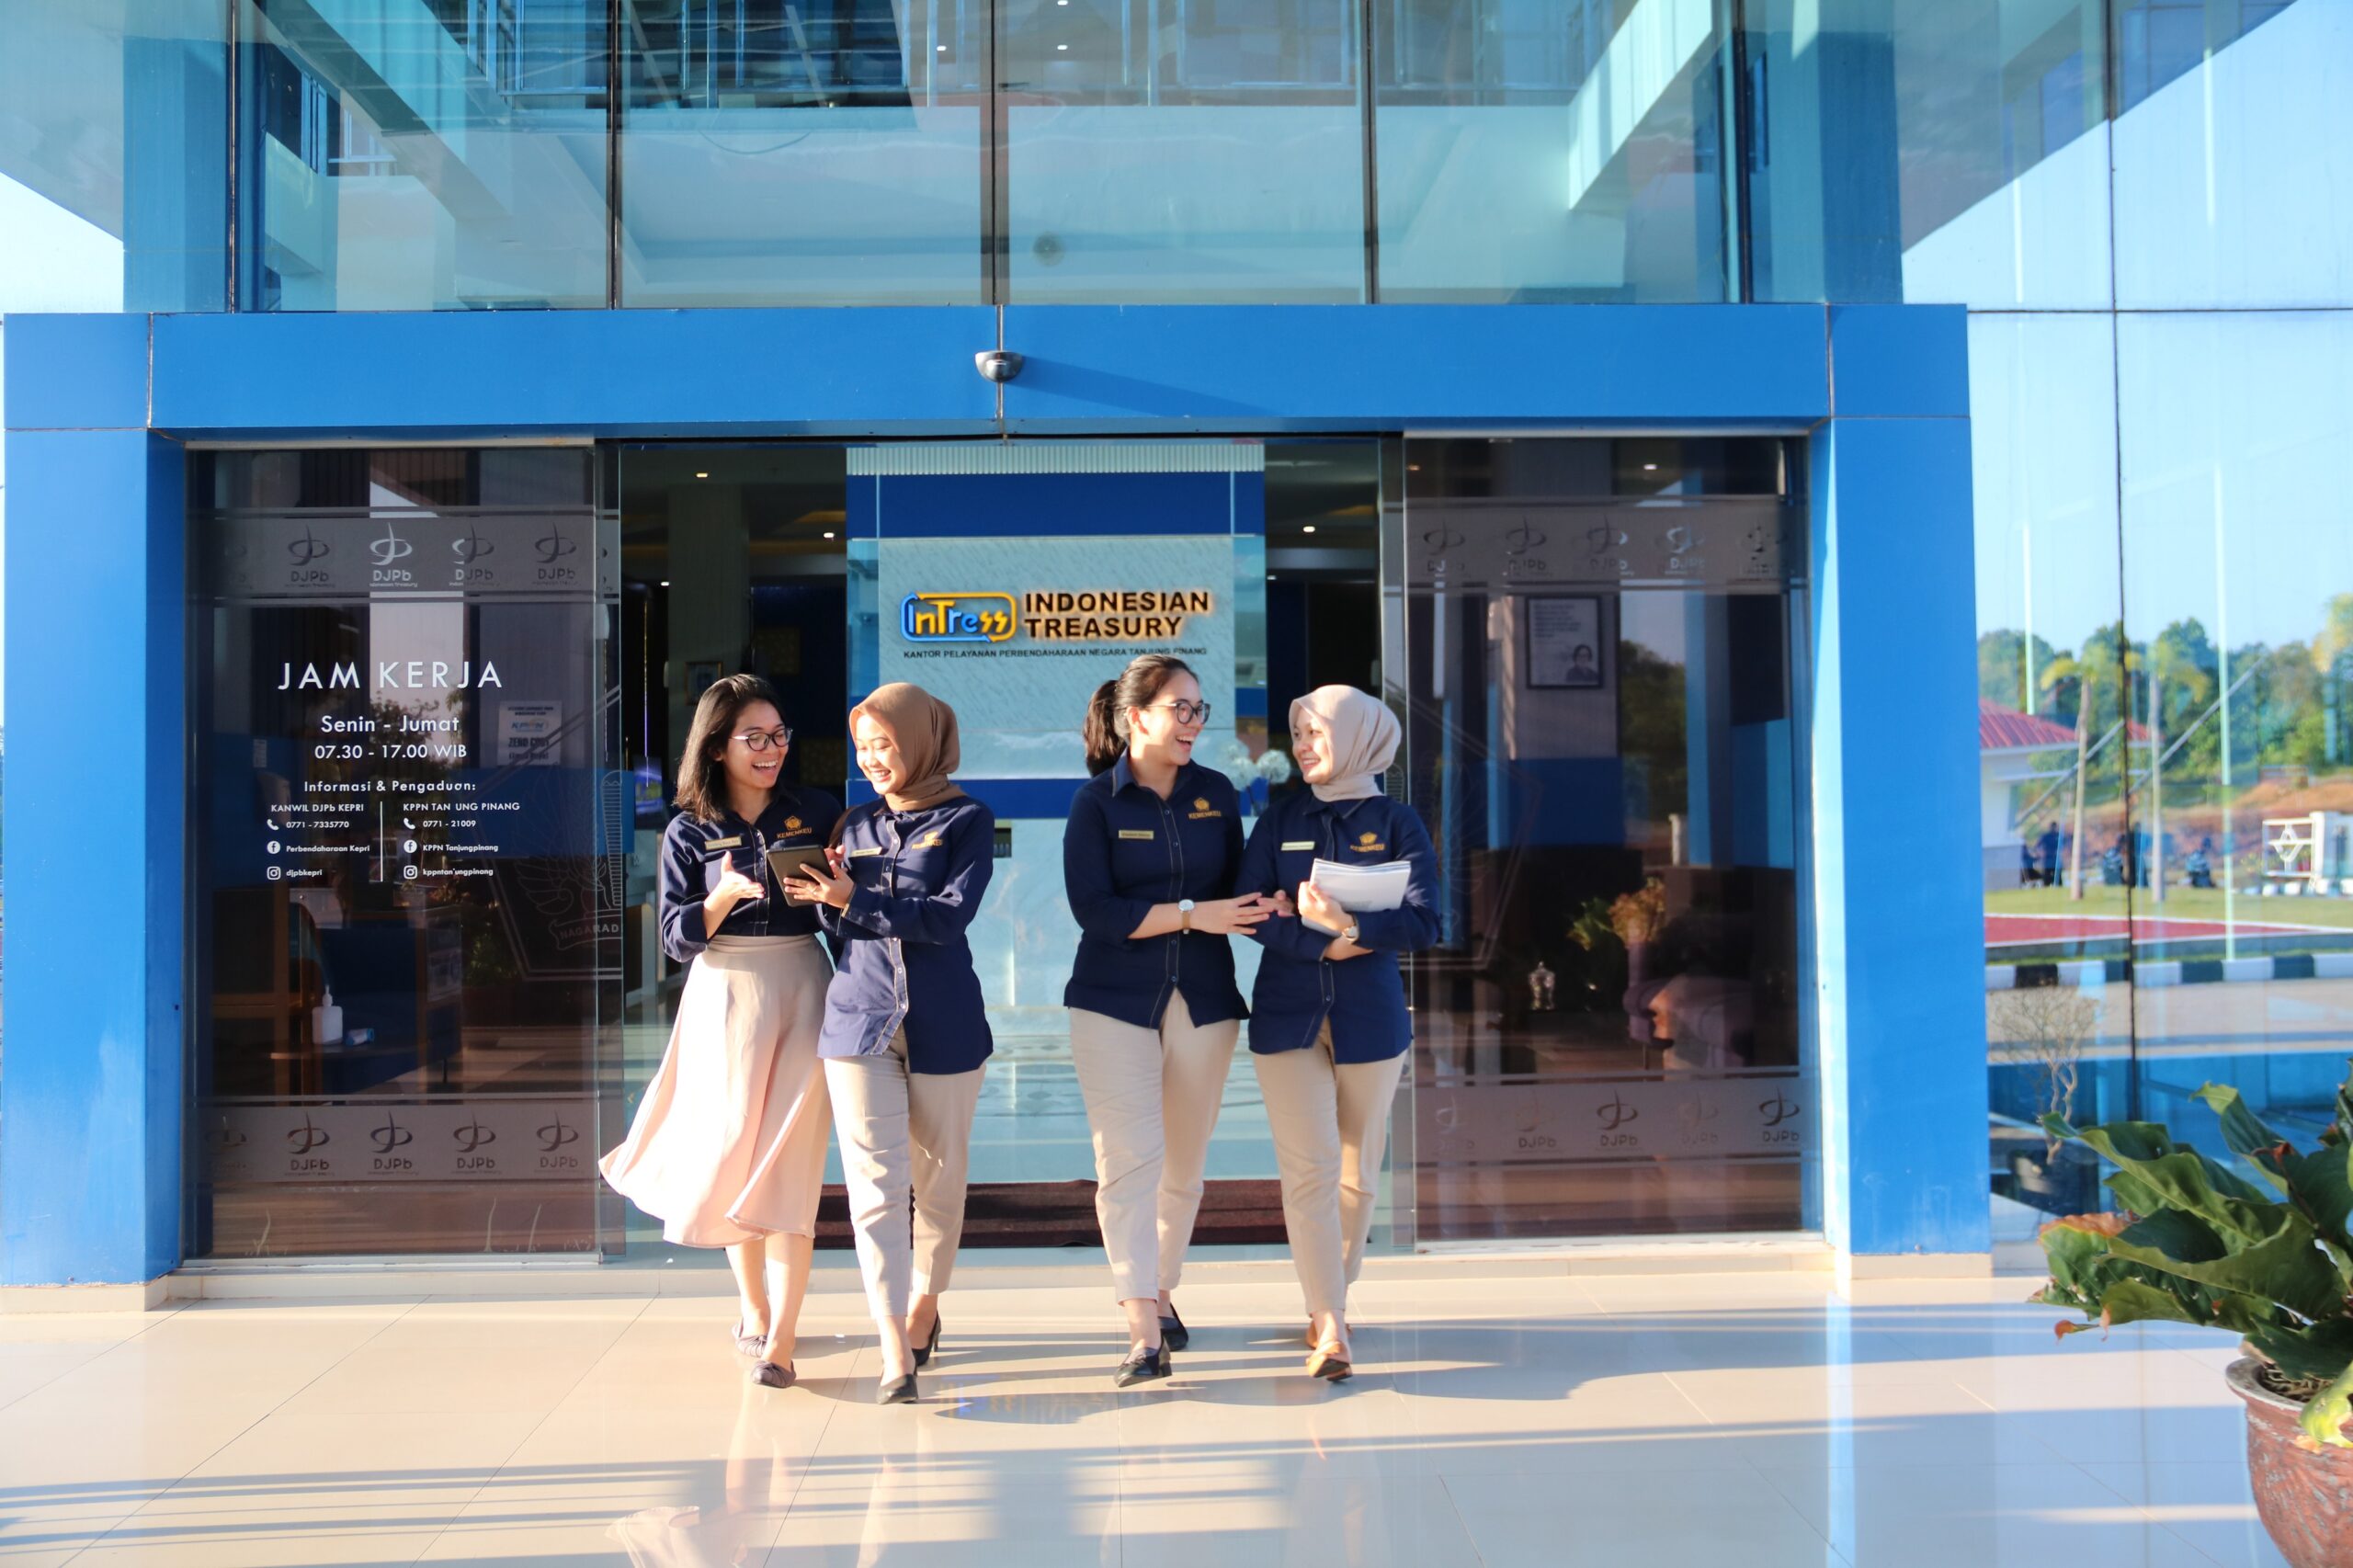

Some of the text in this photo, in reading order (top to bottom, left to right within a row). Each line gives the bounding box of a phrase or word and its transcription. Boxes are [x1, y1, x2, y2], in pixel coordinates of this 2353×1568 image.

[290, 570, 329, 583] DJPb
[372, 569, 411, 582] DJPb
[455, 568, 494, 581] DJPb
[537, 568, 575, 580] DJPb
[1025, 592, 1209, 612] INDONESIAN
[907, 599, 1009, 634] InTress
[1025, 617, 1182, 637] TREASURY
[903, 650, 941, 658] KANTOR
[943, 649, 997, 658] PELAYANAN
[999, 648, 1086, 657] PERBENDAHARAAN
[1088, 647, 1127, 656] NEGARA
[278, 661, 503, 690] JAM KERJA
[321, 715, 376, 733] Senin
[399, 715, 460, 733] Jumat
[314, 745, 363, 759] 07.30
[381, 744, 428, 759] 17.00
[434, 744, 467, 758] WIB
[304, 780, 476, 794] Informasi & Pengaduan:
[271, 804, 310, 812] KANWIL
[338, 803, 364, 812] KEPRI
[481, 802, 521, 811] PINANG
[777, 828, 813, 839] KEMENKEU
[286, 845, 370, 853] Perbendaharaan Kepri
[445, 844, 499, 852] Tanjungpinang
[286, 869, 323, 878] djpbkepri
[423, 868, 494, 877] kppntanungpinang
[1518, 1135, 1557, 1149] DJPb
[1598, 1132, 1638, 1146] DJPb
[1761, 1130, 1800, 1142] DJPb
[290, 1158, 330, 1172] DJPb
[373, 1157, 413, 1170] DJPb
[457, 1156, 495, 1169] DJPb
[540, 1155, 579, 1168] DJPb
